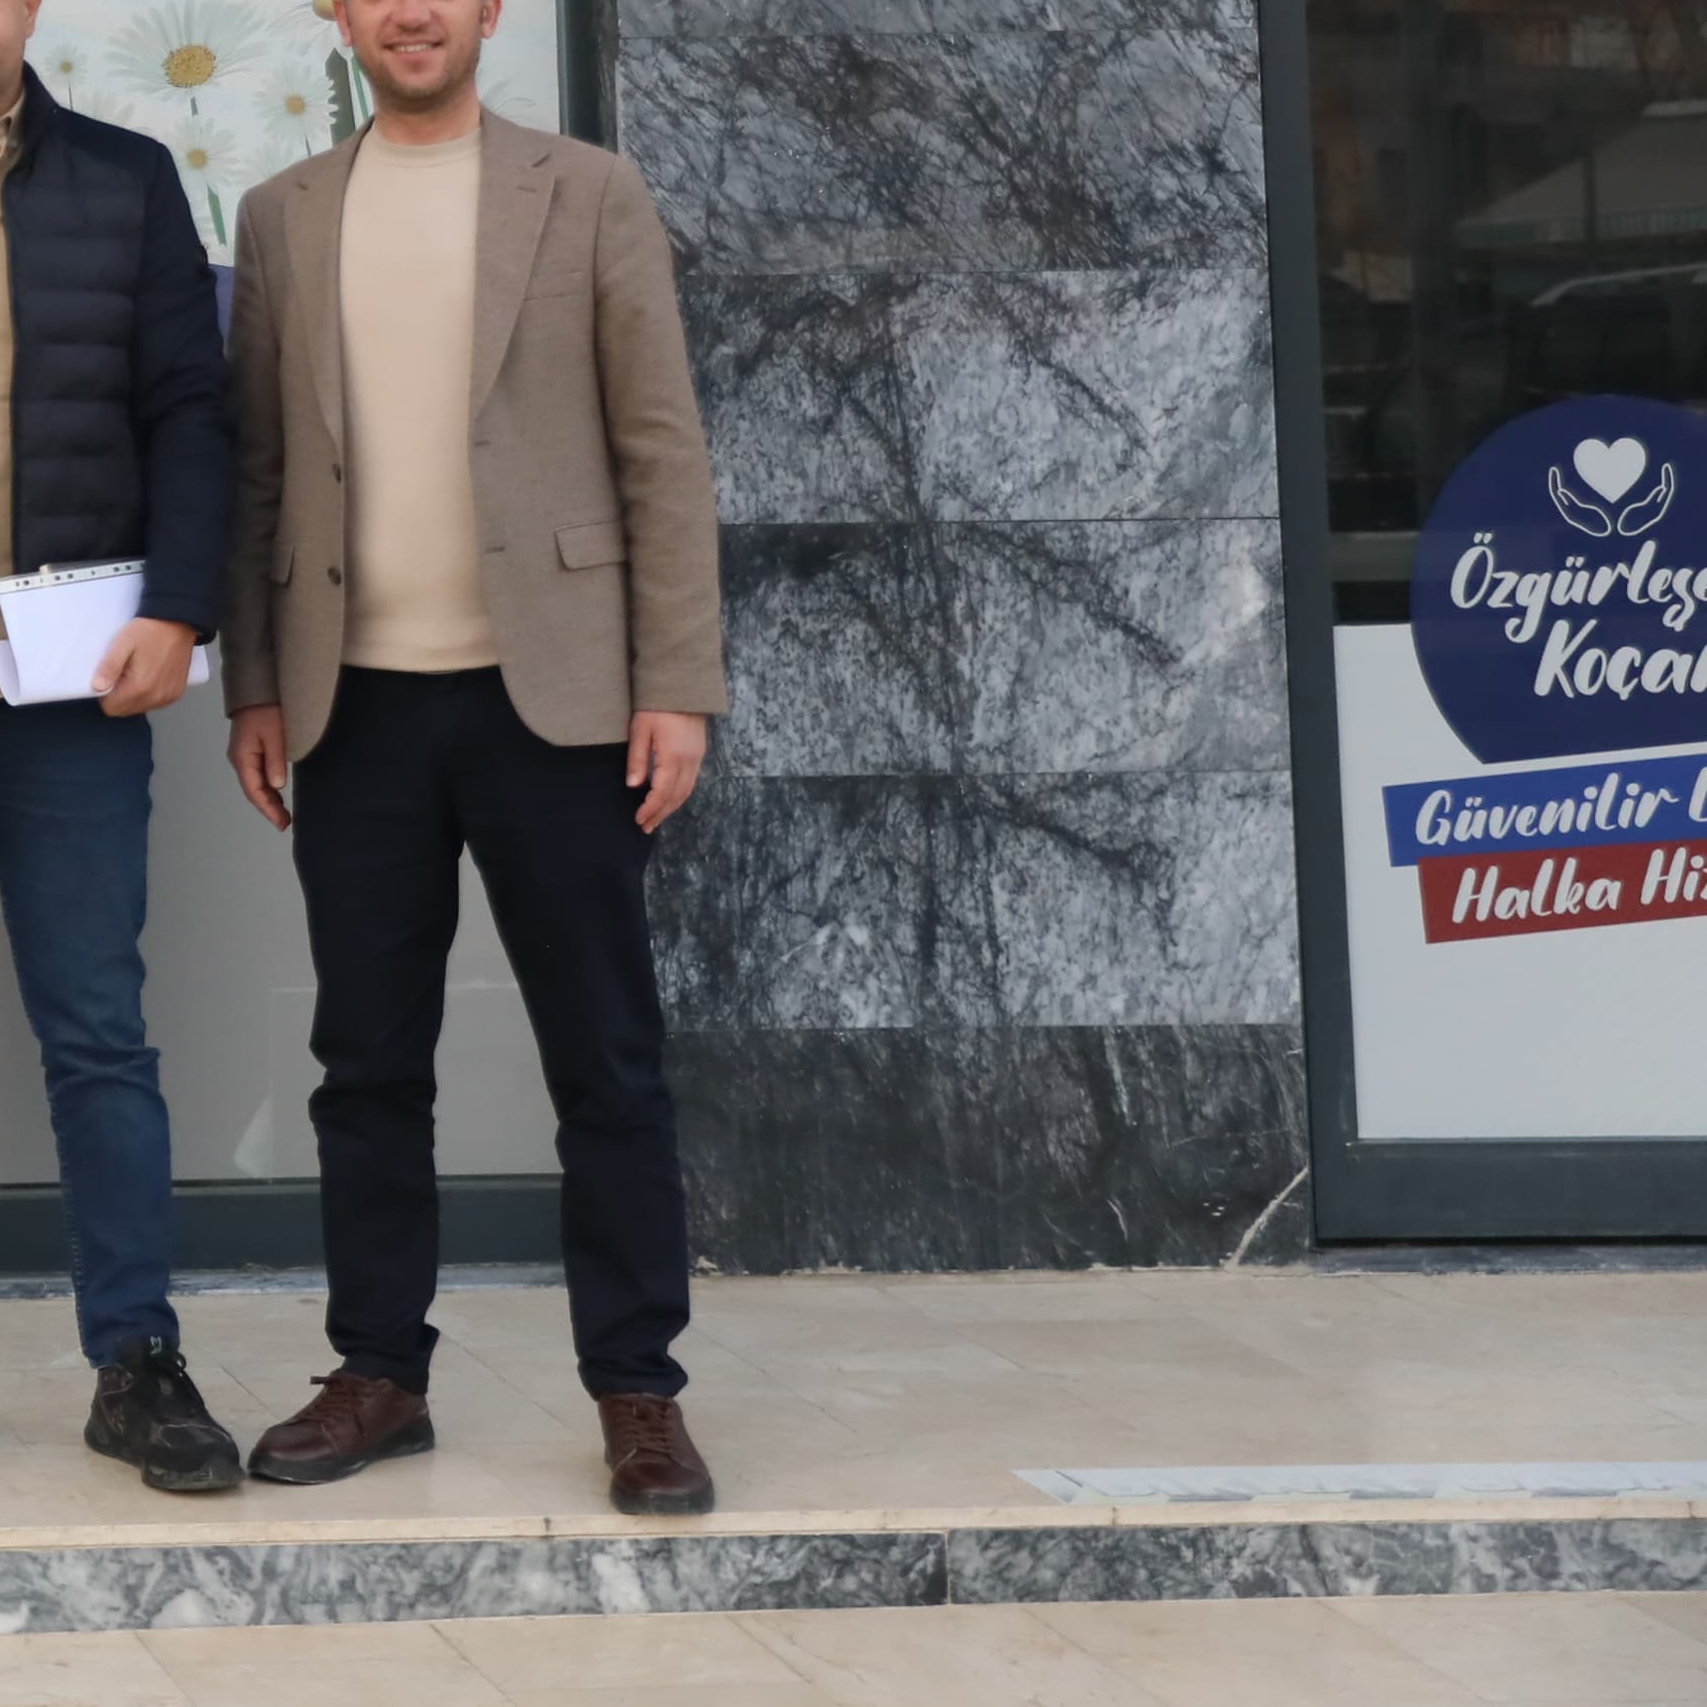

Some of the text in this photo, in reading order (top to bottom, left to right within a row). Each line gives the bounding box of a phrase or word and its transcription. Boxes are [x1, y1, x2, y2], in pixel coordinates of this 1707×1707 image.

[1414, 772, 1679, 847] Güvenilir
[1451, 846, 1707, 925] Halka Hi
